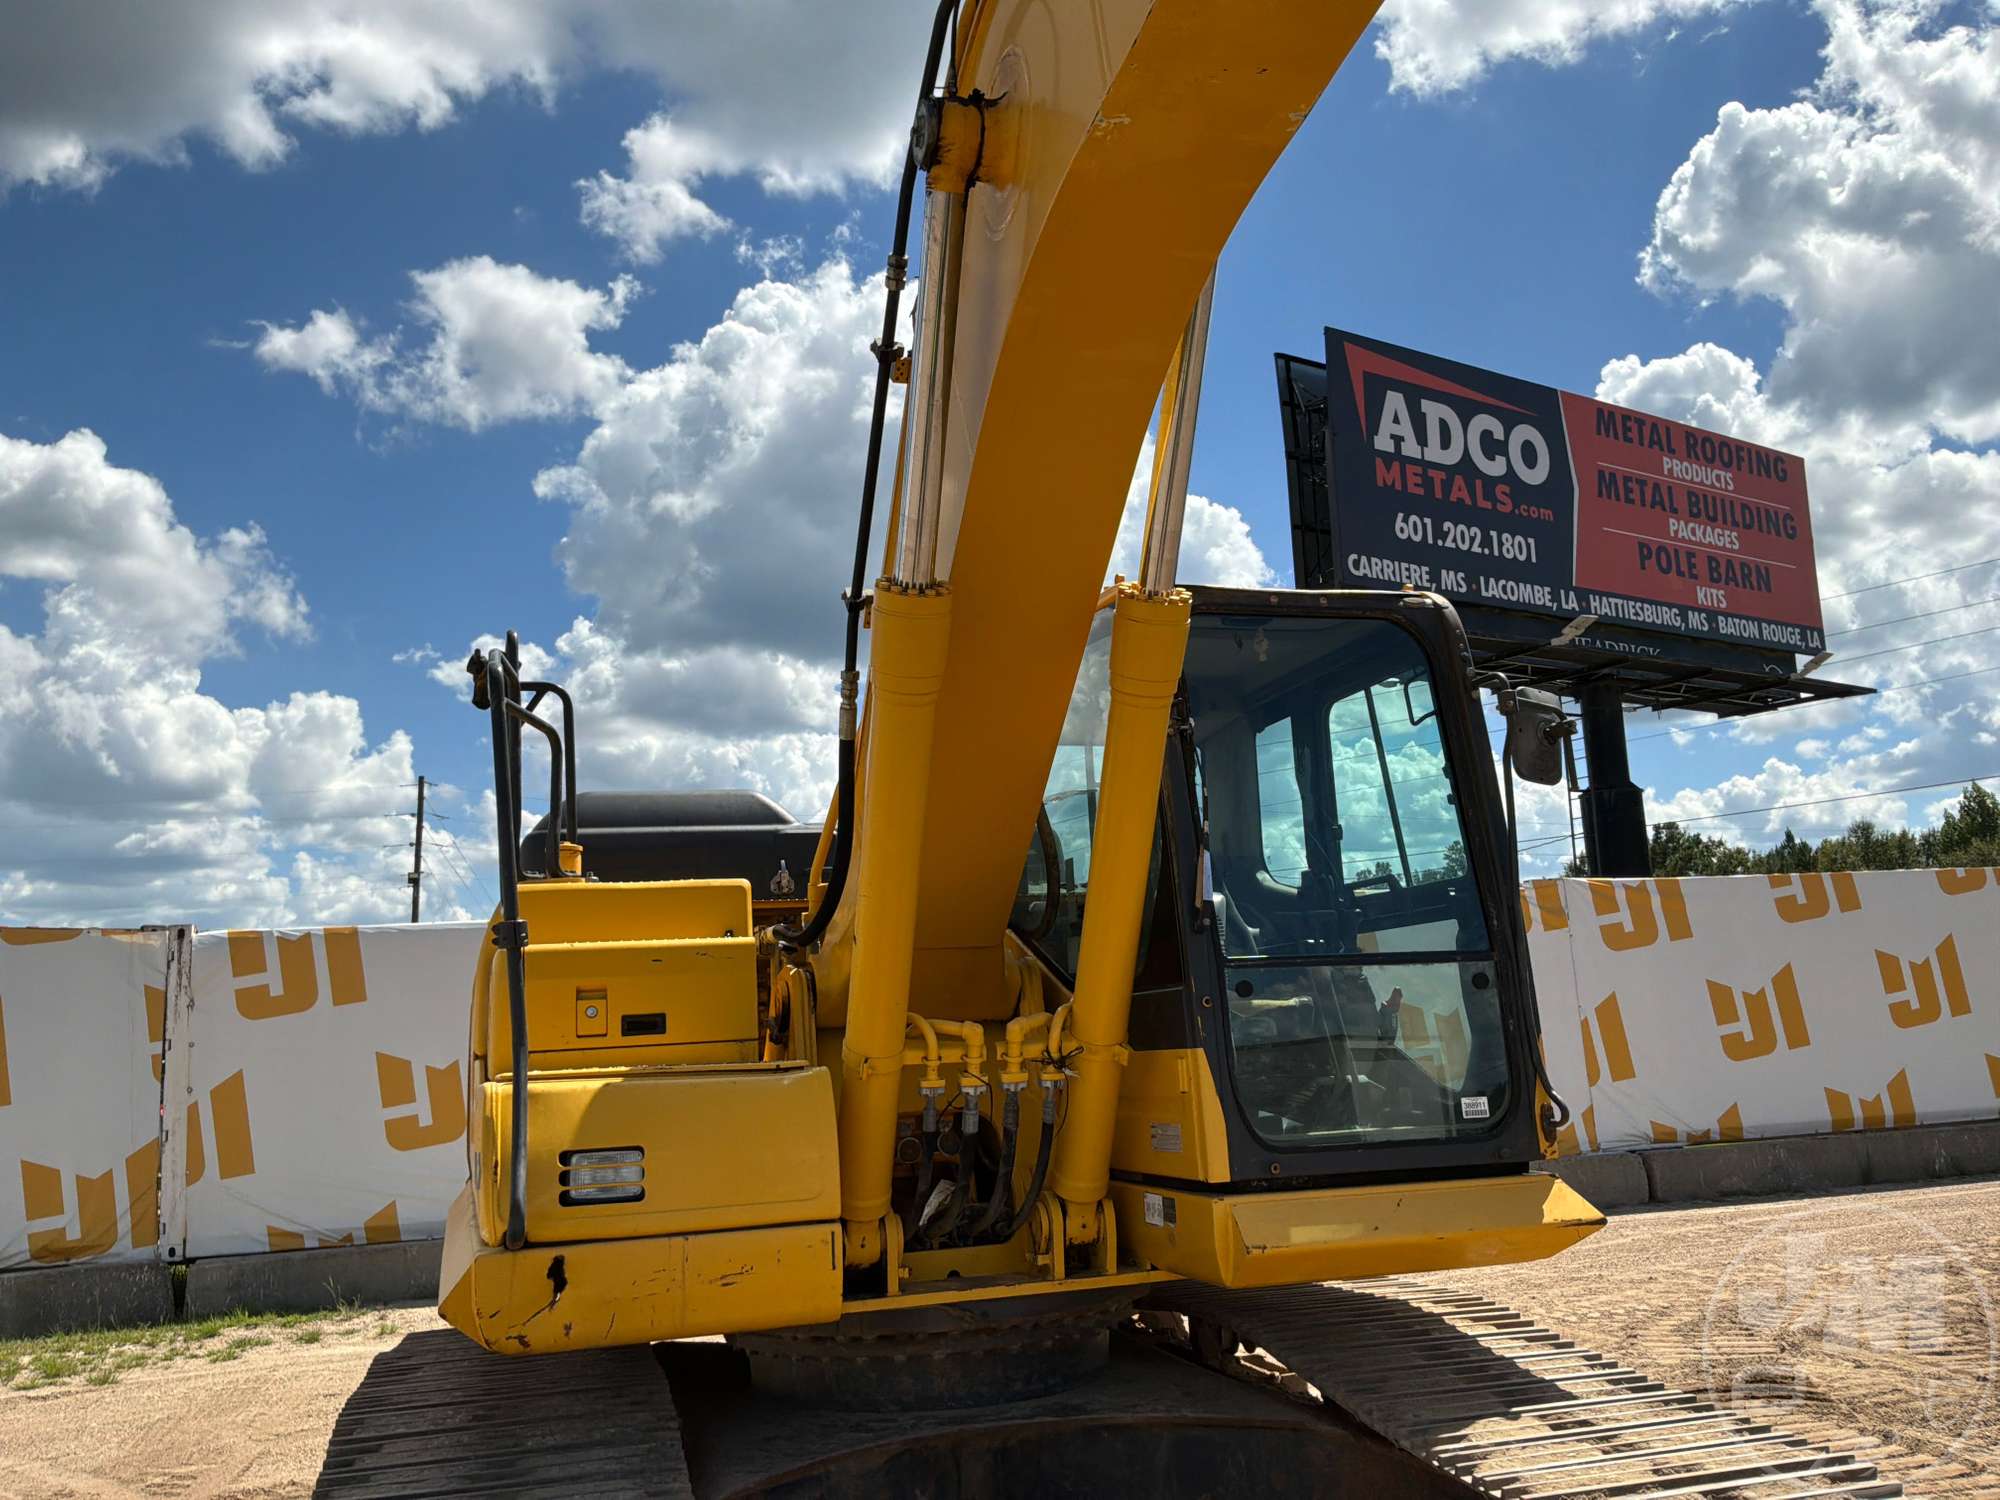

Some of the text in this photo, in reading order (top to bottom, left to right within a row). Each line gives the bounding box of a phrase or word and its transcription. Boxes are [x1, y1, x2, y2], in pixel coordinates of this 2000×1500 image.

[1374, 390, 1550, 485] ADCO
[1595, 407, 1788, 482] METAL ROOFING
[1663, 455, 1735, 490] PRODUCTS
[1597, 470, 1798, 540] METAL BUILDING
[1394, 512, 1537, 563] 601.202.1801
[1669, 518, 1740, 550] PACKAGES
[1637, 541, 1773, 593] POLE BARN
[1347, 553, 1822, 650] CARRIERE, MS LACOMBE, LA HATTIESBURG, MS BATON ROUGE, LA
[1696, 585, 1728, 608] KITS
